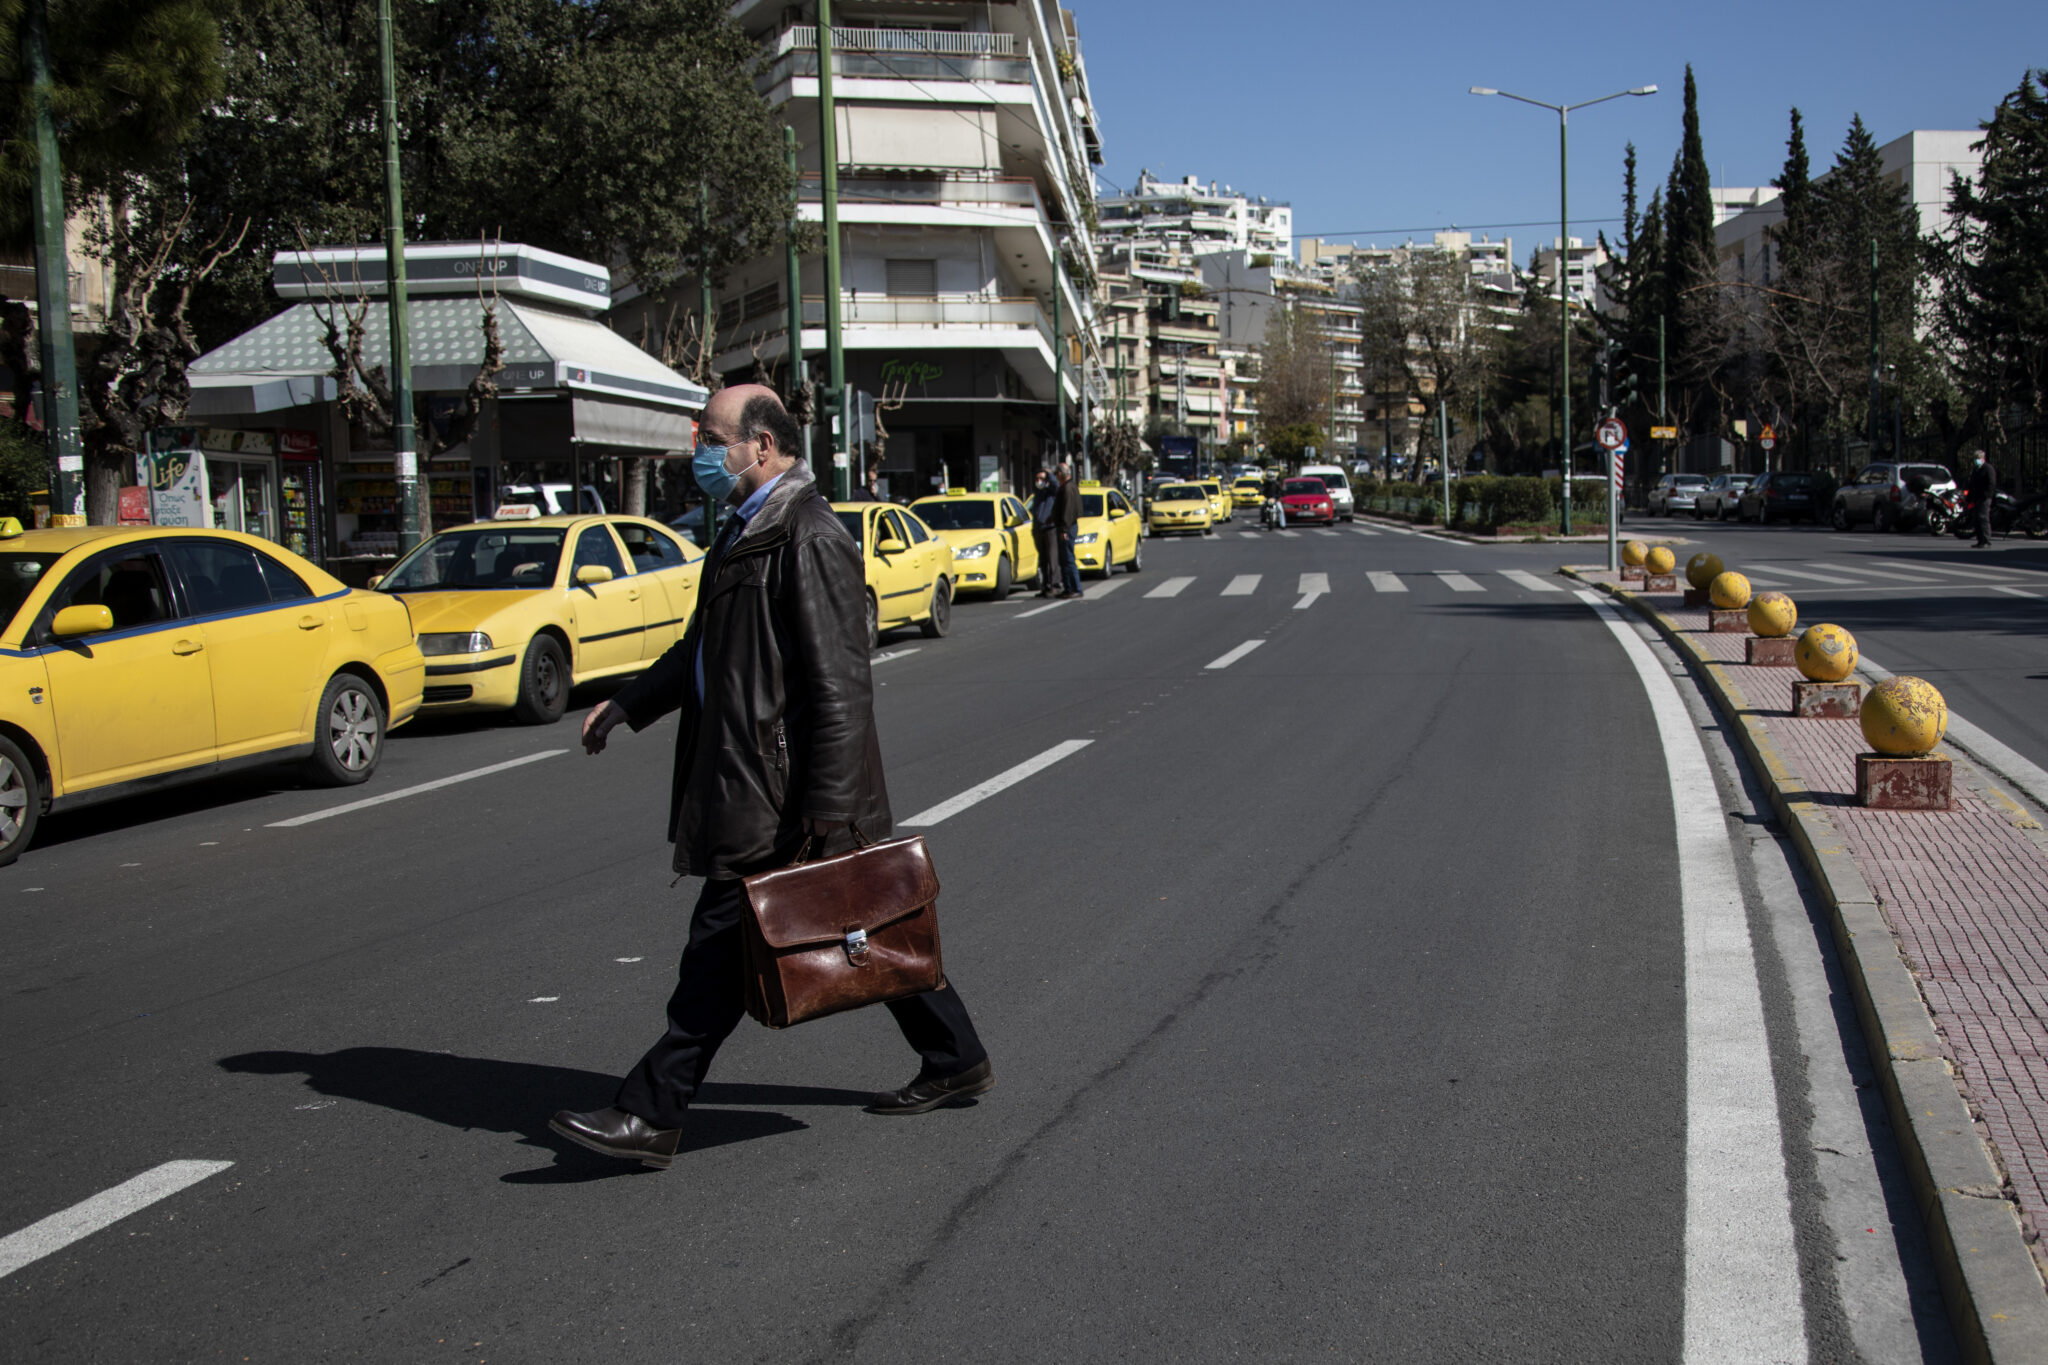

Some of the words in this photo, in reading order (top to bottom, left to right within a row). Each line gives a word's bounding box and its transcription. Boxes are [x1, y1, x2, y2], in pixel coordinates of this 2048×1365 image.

[488, 260, 508, 272] UP
[584, 277, 597, 291] ONE
[597, 280, 607, 292] UP
[528, 370, 545, 380] UP
[151, 457, 187, 490] Life
